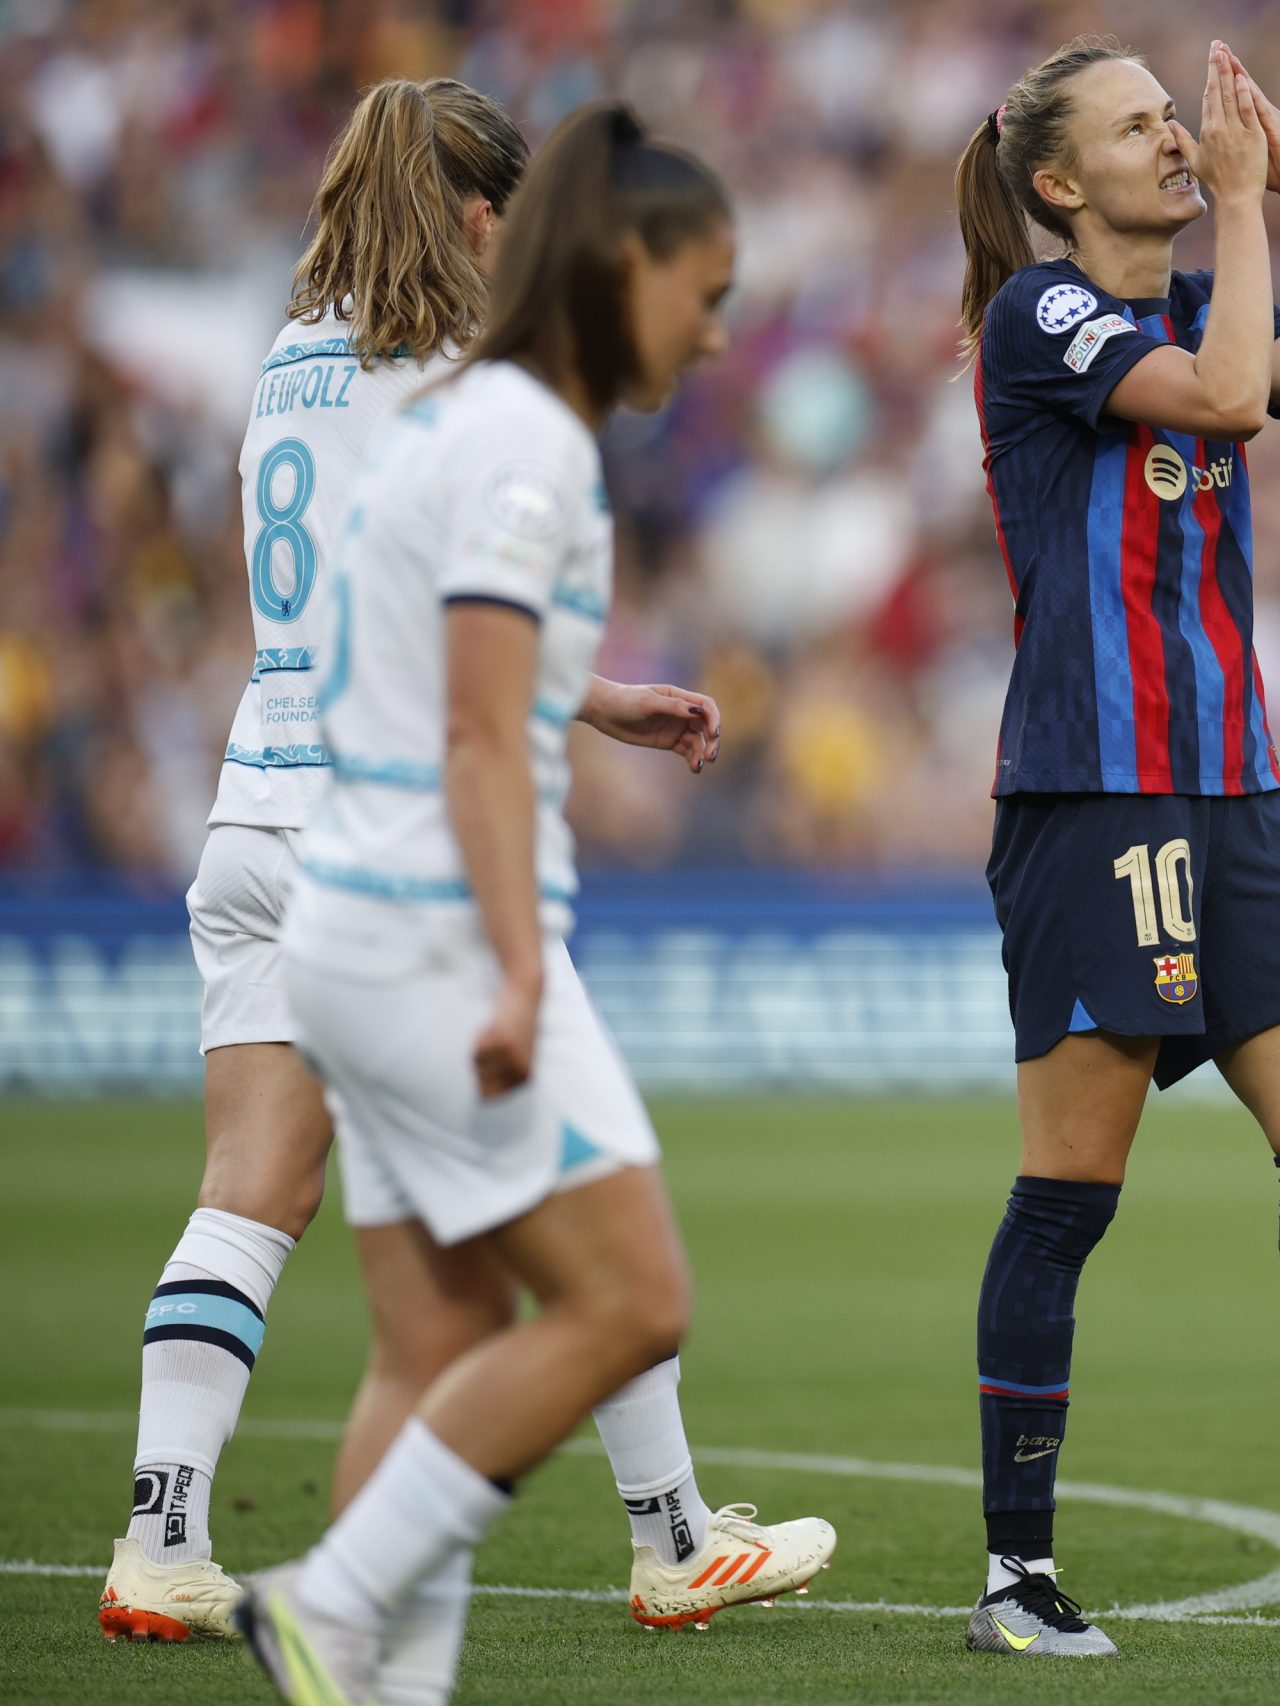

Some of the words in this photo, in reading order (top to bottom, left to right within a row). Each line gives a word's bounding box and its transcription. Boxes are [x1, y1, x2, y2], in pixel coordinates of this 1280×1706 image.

[256, 366, 357, 419] LEUPOLZ
[252, 437, 318, 624] 8
[1113, 838, 1197, 948] 10
[1169, 974, 1187, 982] FCB
[145, 1303, 198, 1319] CFC
